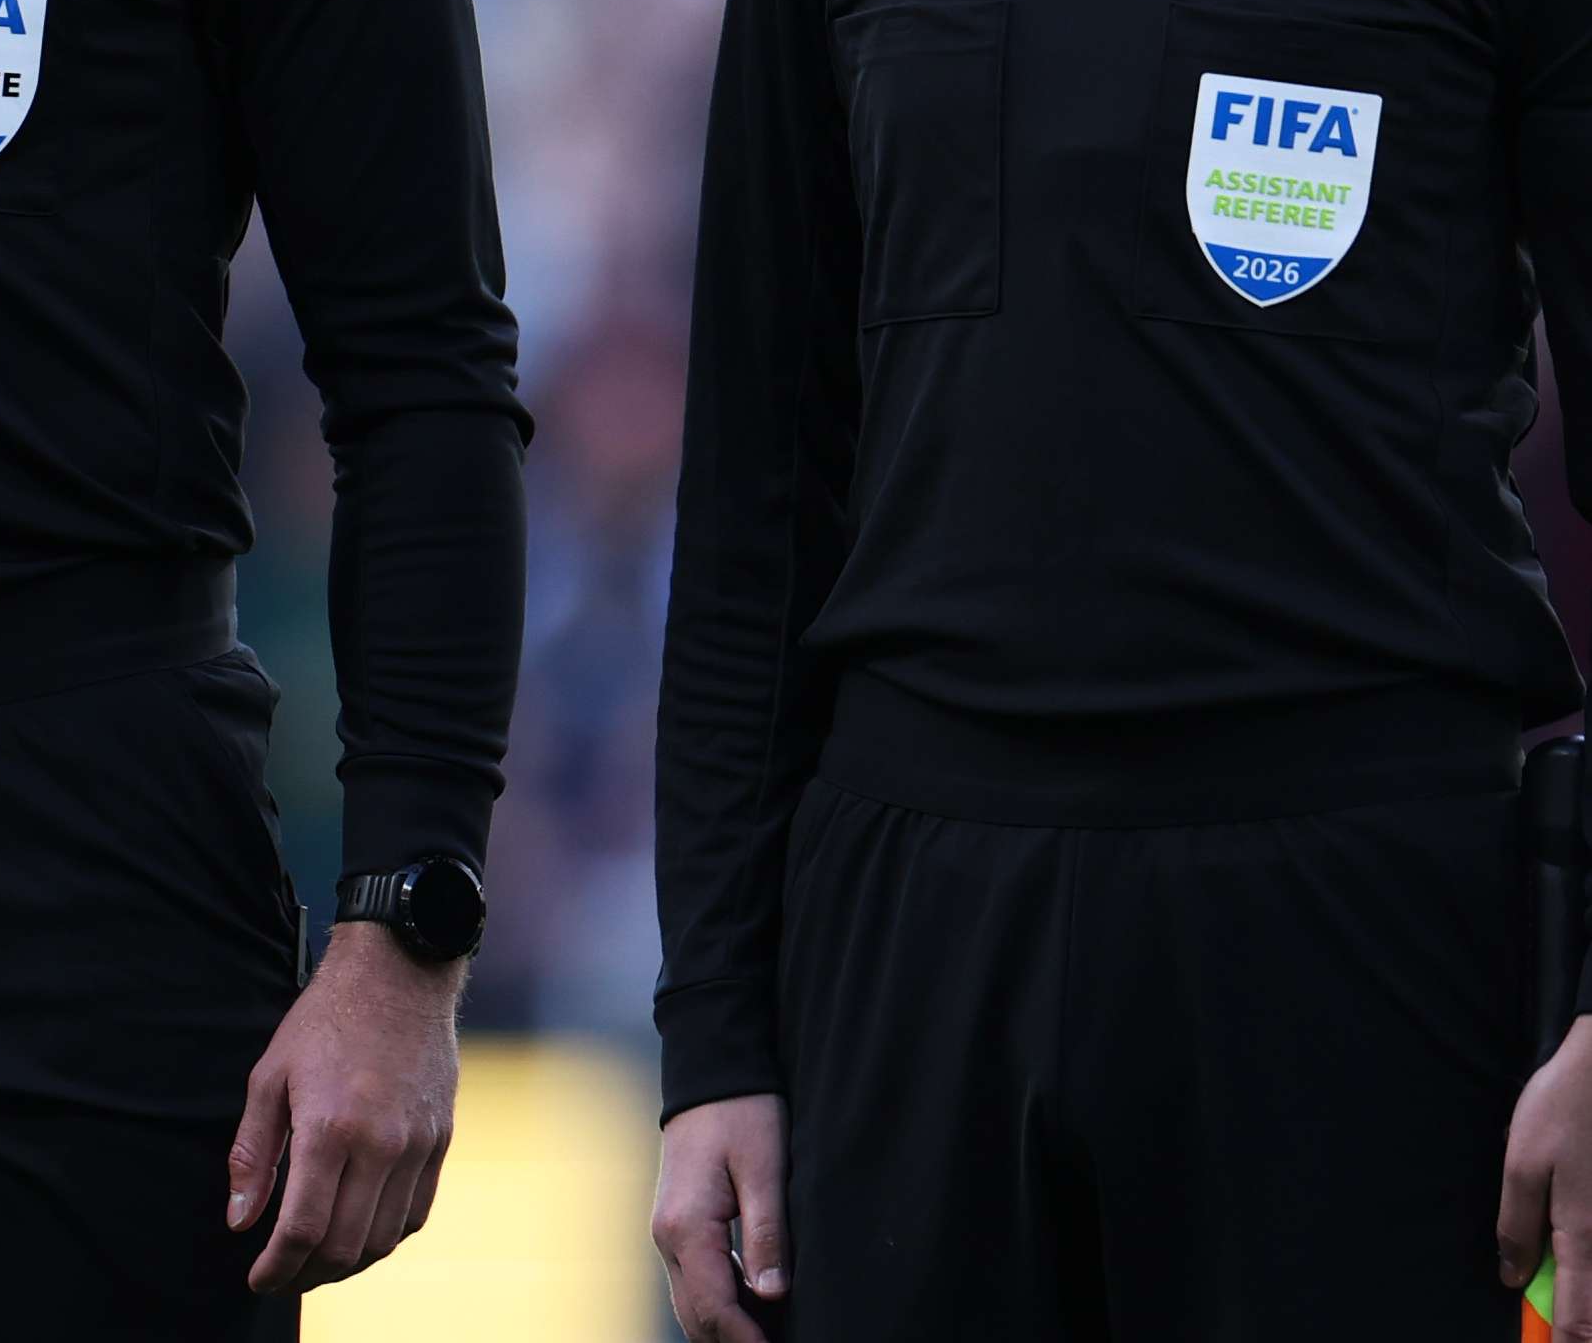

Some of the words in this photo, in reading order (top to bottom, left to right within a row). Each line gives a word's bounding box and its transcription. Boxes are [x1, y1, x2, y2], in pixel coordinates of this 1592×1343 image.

[1210, 90, 1358, 158] FIFA
[1204, 168, 1352, 206] ASSISTANT
[1212, 193, 1336, 231] REFEREE
[1231, 255, 1301, 285] 2026
